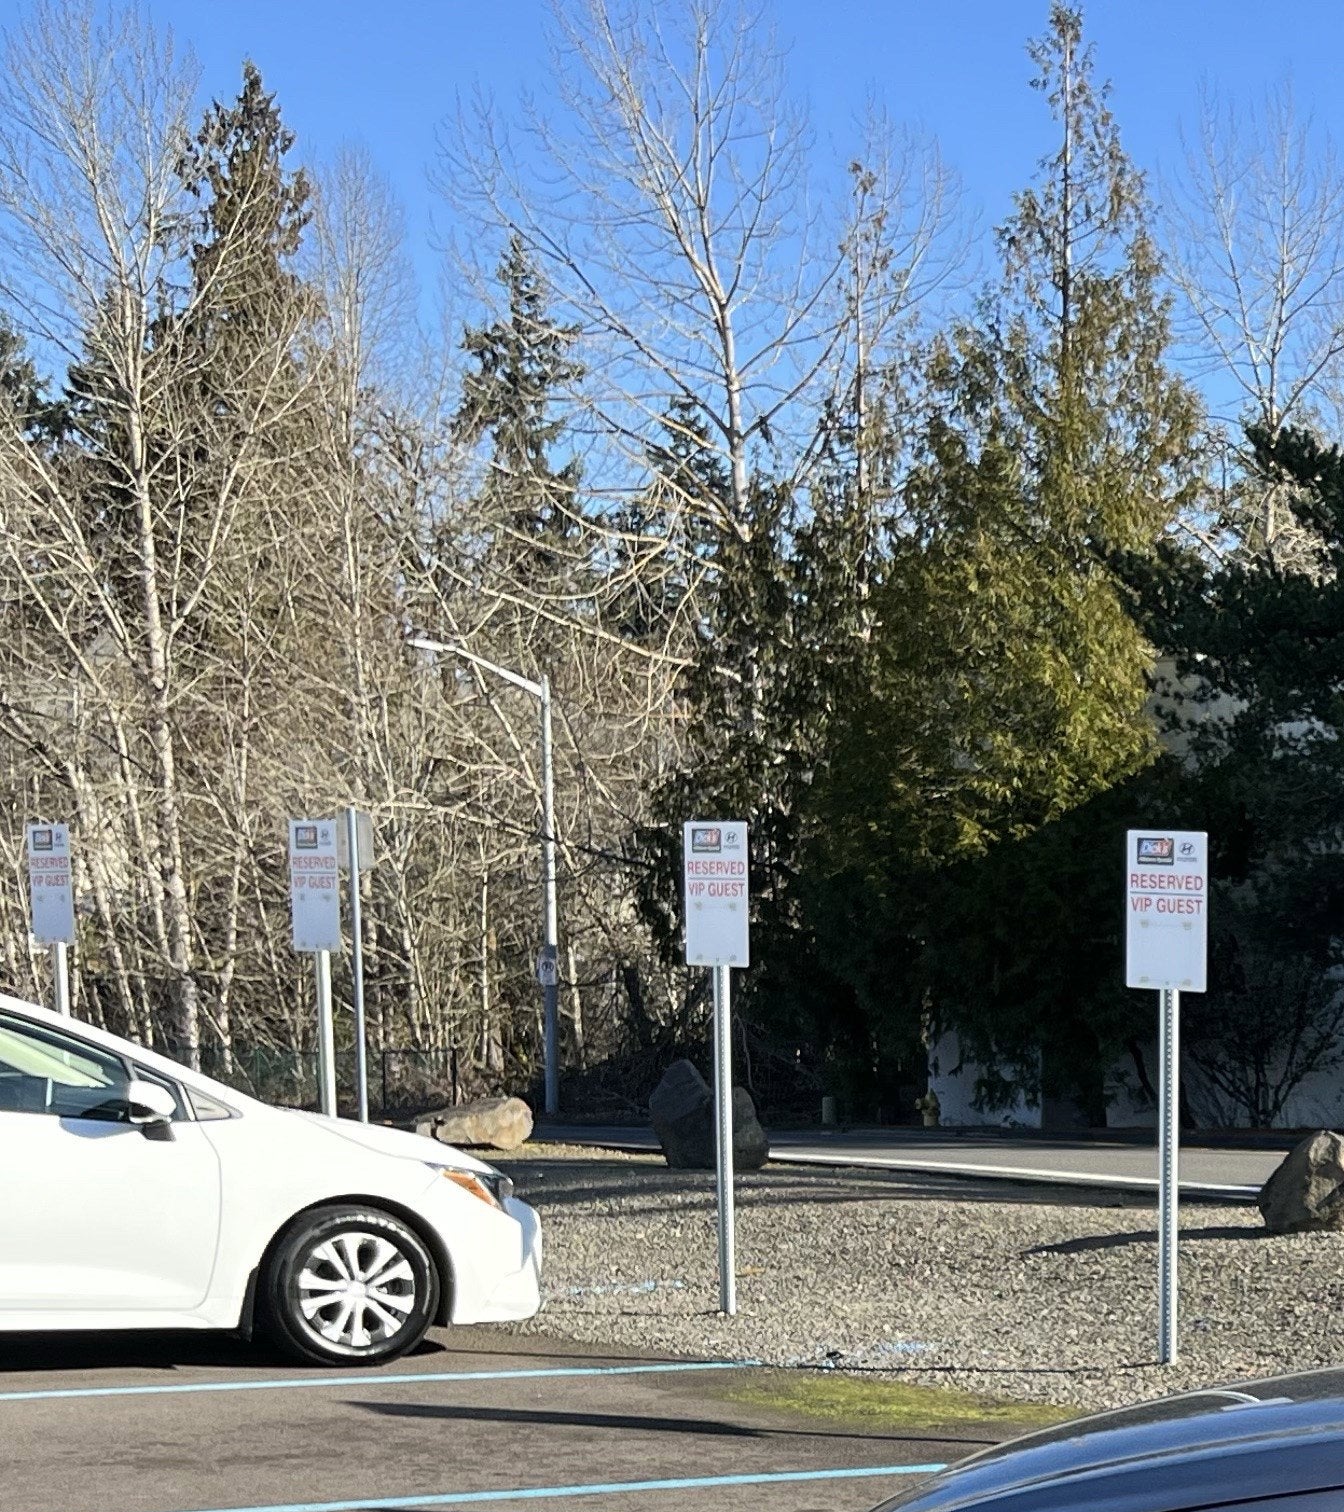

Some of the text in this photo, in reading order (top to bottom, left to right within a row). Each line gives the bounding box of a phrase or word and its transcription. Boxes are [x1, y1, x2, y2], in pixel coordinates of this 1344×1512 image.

[292, 856, 336, 869] RESERVED
[687, 861, 745, 875] RESERVED
[308, 876, 336, 889] GUEST
[1130, 873, 1204, 891] RESERVED
[688, 882, 745, 897] VIP GUEST
[1131, 897, 1203, 914] VIP GUEST
